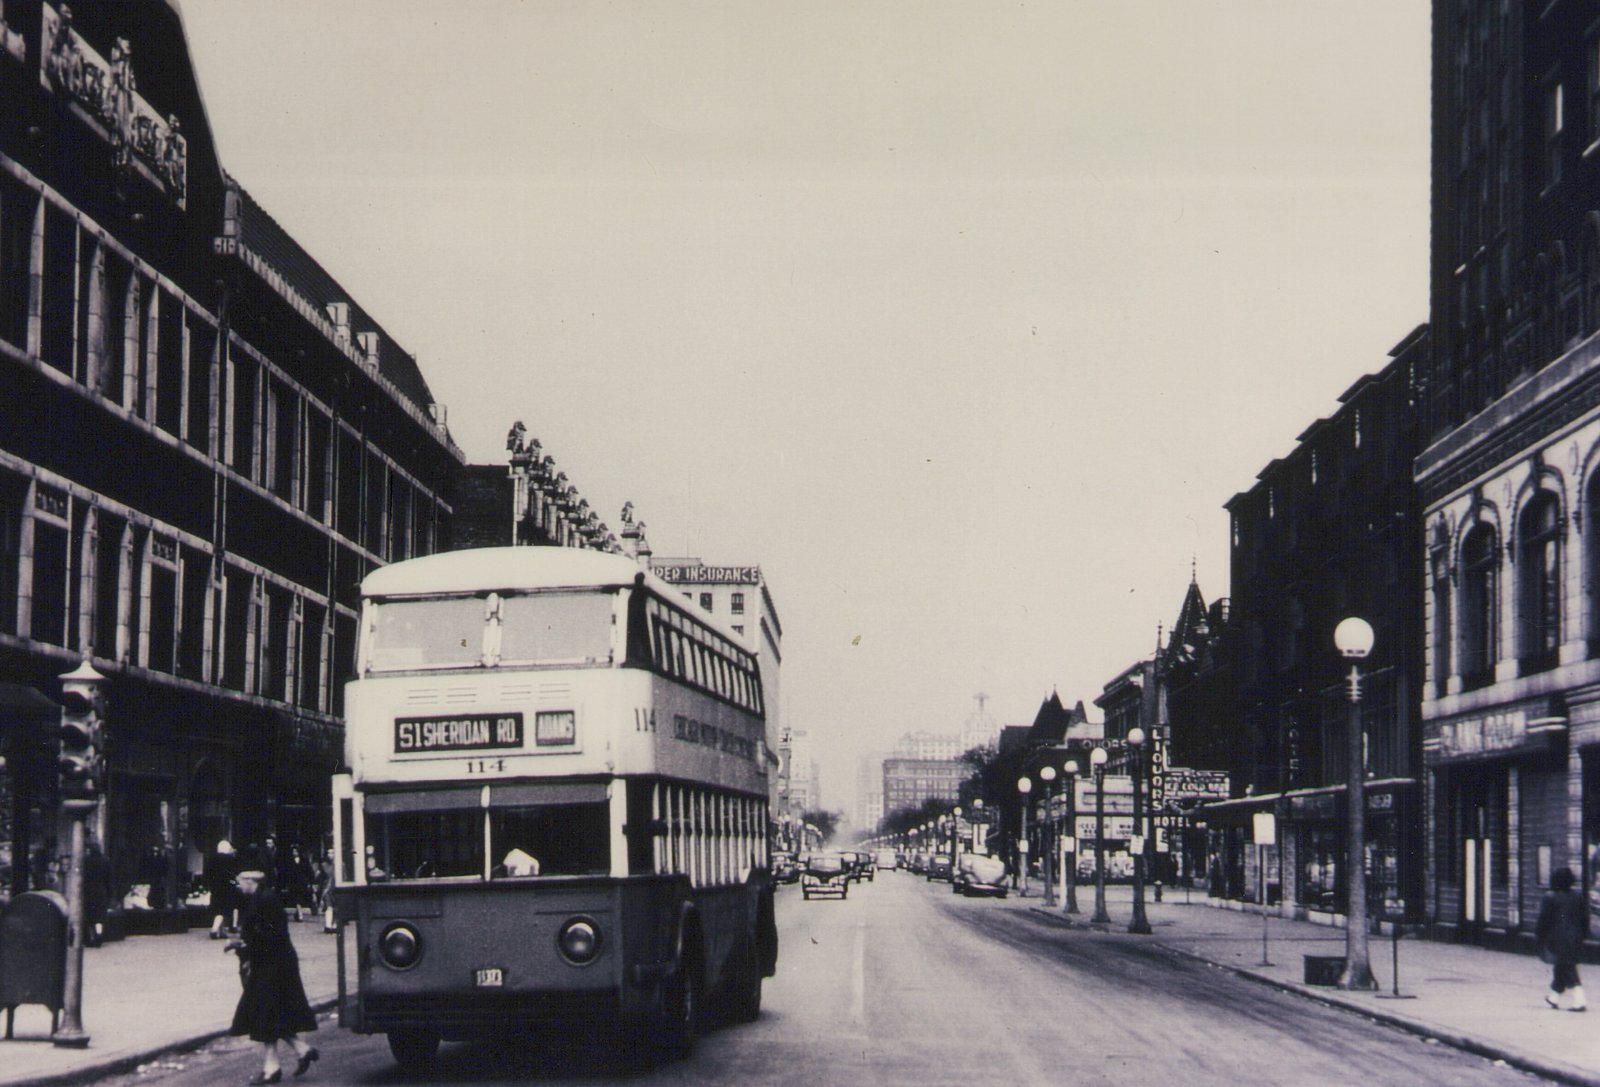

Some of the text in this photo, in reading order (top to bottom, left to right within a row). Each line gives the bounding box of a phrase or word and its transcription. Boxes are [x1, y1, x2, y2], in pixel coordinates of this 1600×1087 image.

[686, 567, 759, 582] INSURANCE
[423, 719, 490, 747] SHERIDAN
[467, 759, 507, 774] 114
[1152, 728, 1163, 811] LIQUORS
[1153, 816, 1191, 828] HOTEL
